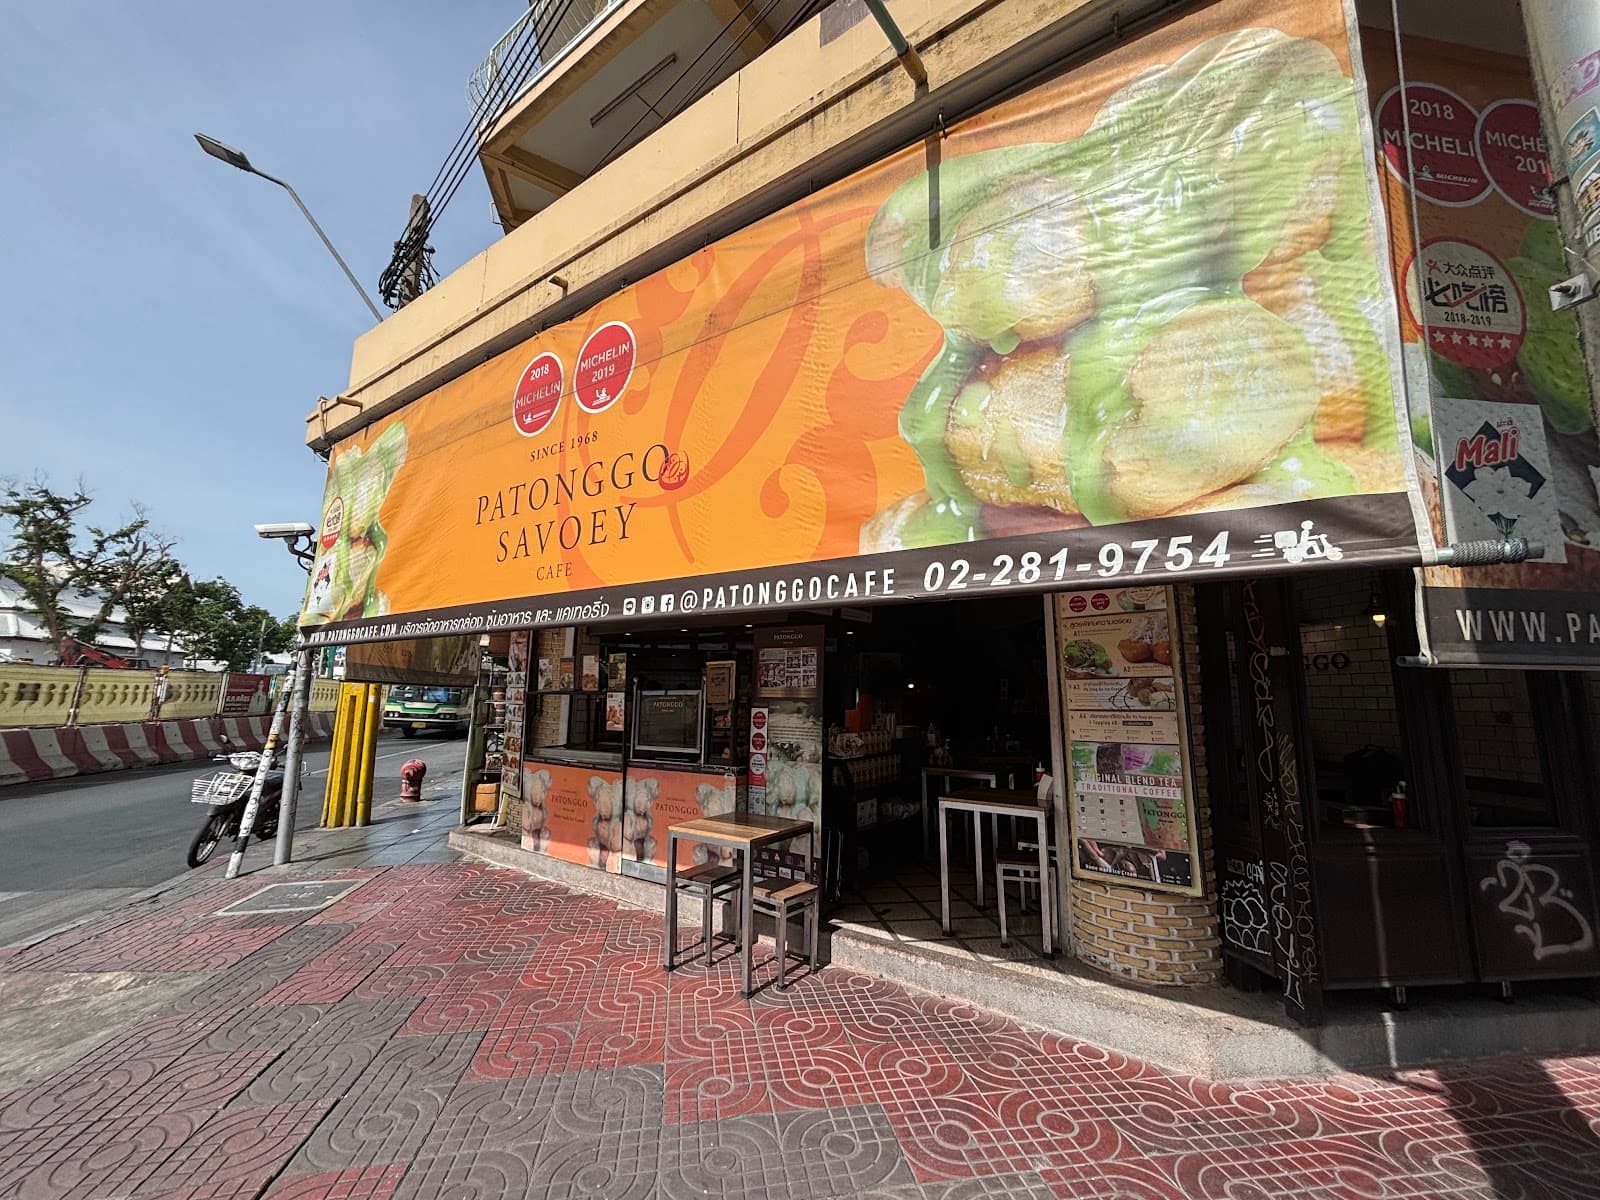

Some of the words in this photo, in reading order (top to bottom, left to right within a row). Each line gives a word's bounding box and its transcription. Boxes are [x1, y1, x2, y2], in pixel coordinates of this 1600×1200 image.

[1409, 99, 1454, 121] 2018
[1486, 130, 1546, 153] MICHE
[1514, 155, 1546, 175] 201
[1443, 262, 1495, 279] 大众点评
[1444, 311, 1492, 327] 2018-2019
[580, 341, 631, 372] MICHELIN
[530, 363, 550, 381] 2018
[591, 363, 615, 383] 2019
[515, 380, 561, 409] MICHELIN
[530, 441, 565, 462] SINCE
[570, 430, 599, 449] 1968
[1456, 428, 1519, 471] Mali
[475, 444, 670, 525] PATONGGO
[497, 502, 637, 563] SAVOEY
[923, 530, 1231, 592] 02-281-9754
[536, 562, 573, 581] CAFE
[680, 568, 895, 613] @PATONGGOCAFE
[535, 609, 552, 622] และ
[309, 623, 397, 643] WWW.PATONGGOCAFE.COM
[1080, 771, 1122, 784] ORIGINAL
[1125, 775, 1155, 786] BLEND
[1159, 778, 1177, 787] TEA
[1081, 783, 1138, 794] TRADITIONAL
[1143, 788, 1177, 797] COFFEE
[655, 802, 698, 816] PATONGGO
